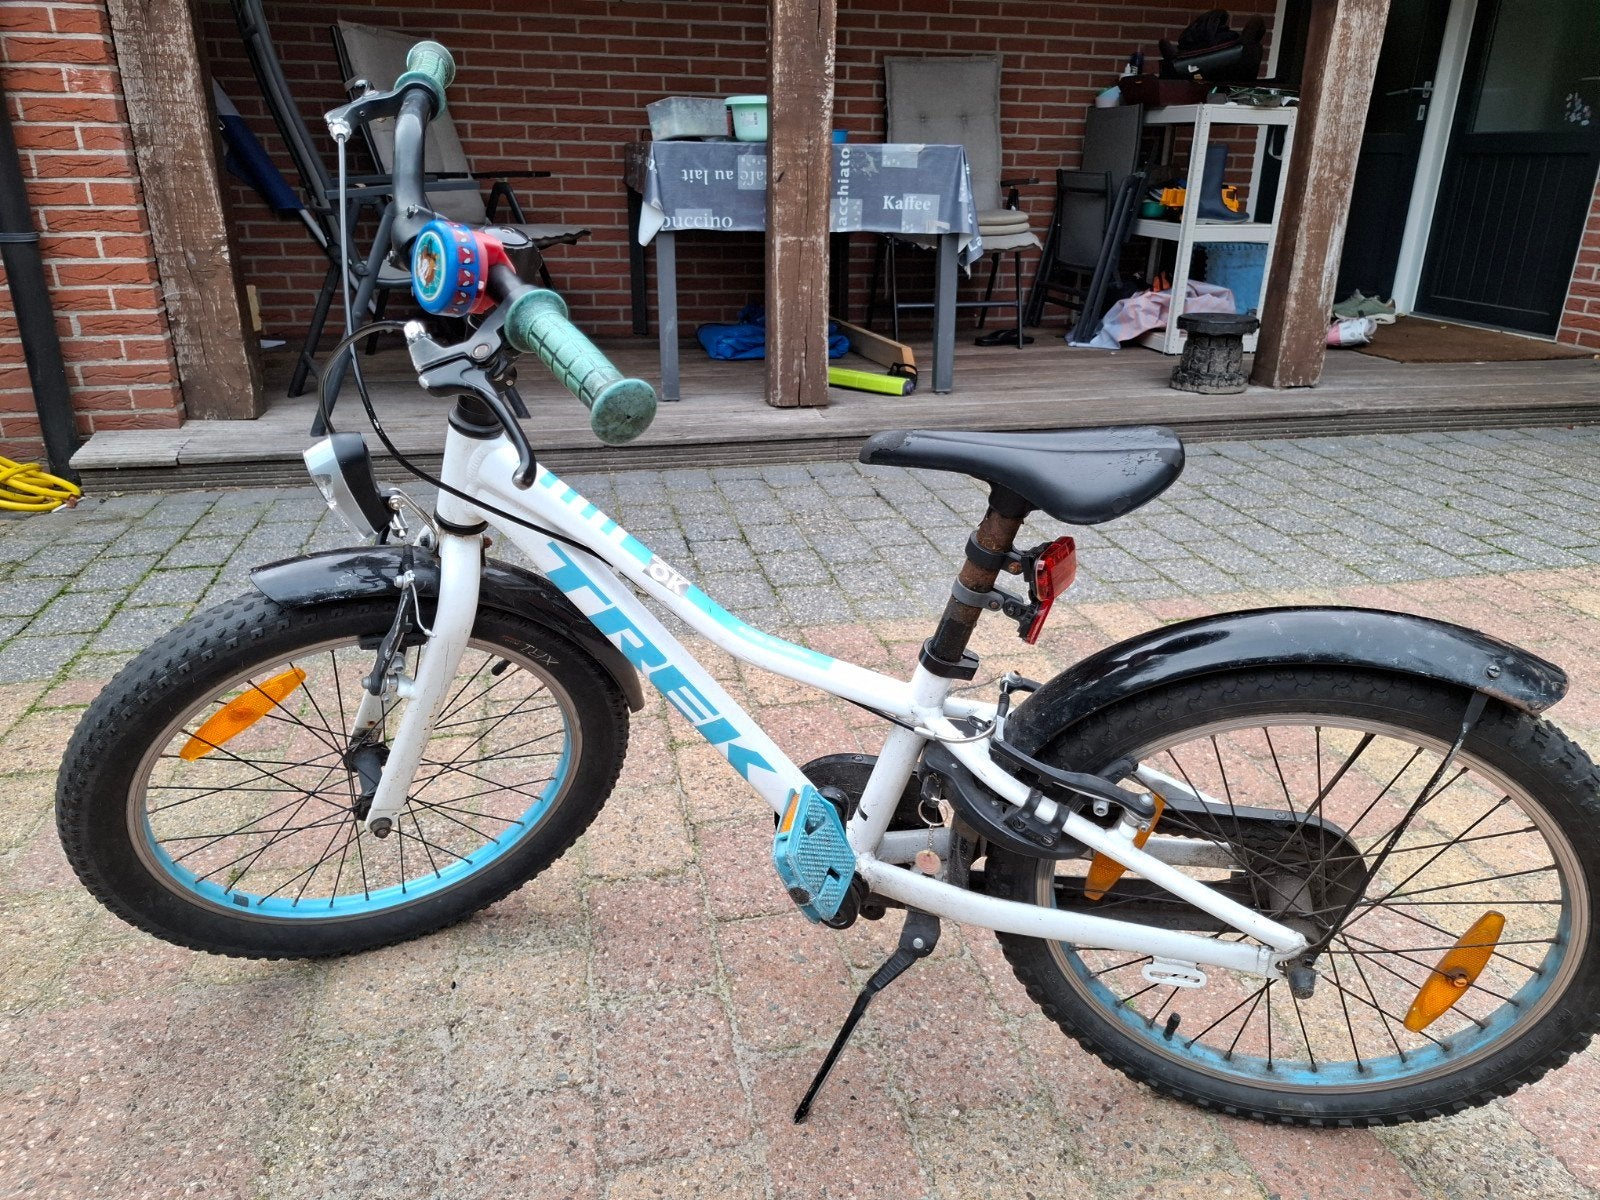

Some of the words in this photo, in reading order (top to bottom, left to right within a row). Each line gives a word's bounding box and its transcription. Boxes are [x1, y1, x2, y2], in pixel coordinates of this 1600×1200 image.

[681, 168, 709, 185] lait
[714, 169, 734, 181] au
[739, 170, 767, 185] afé
[882, 195, 932, 210] Kaffee
[546, 541, 778, 782] TREK
